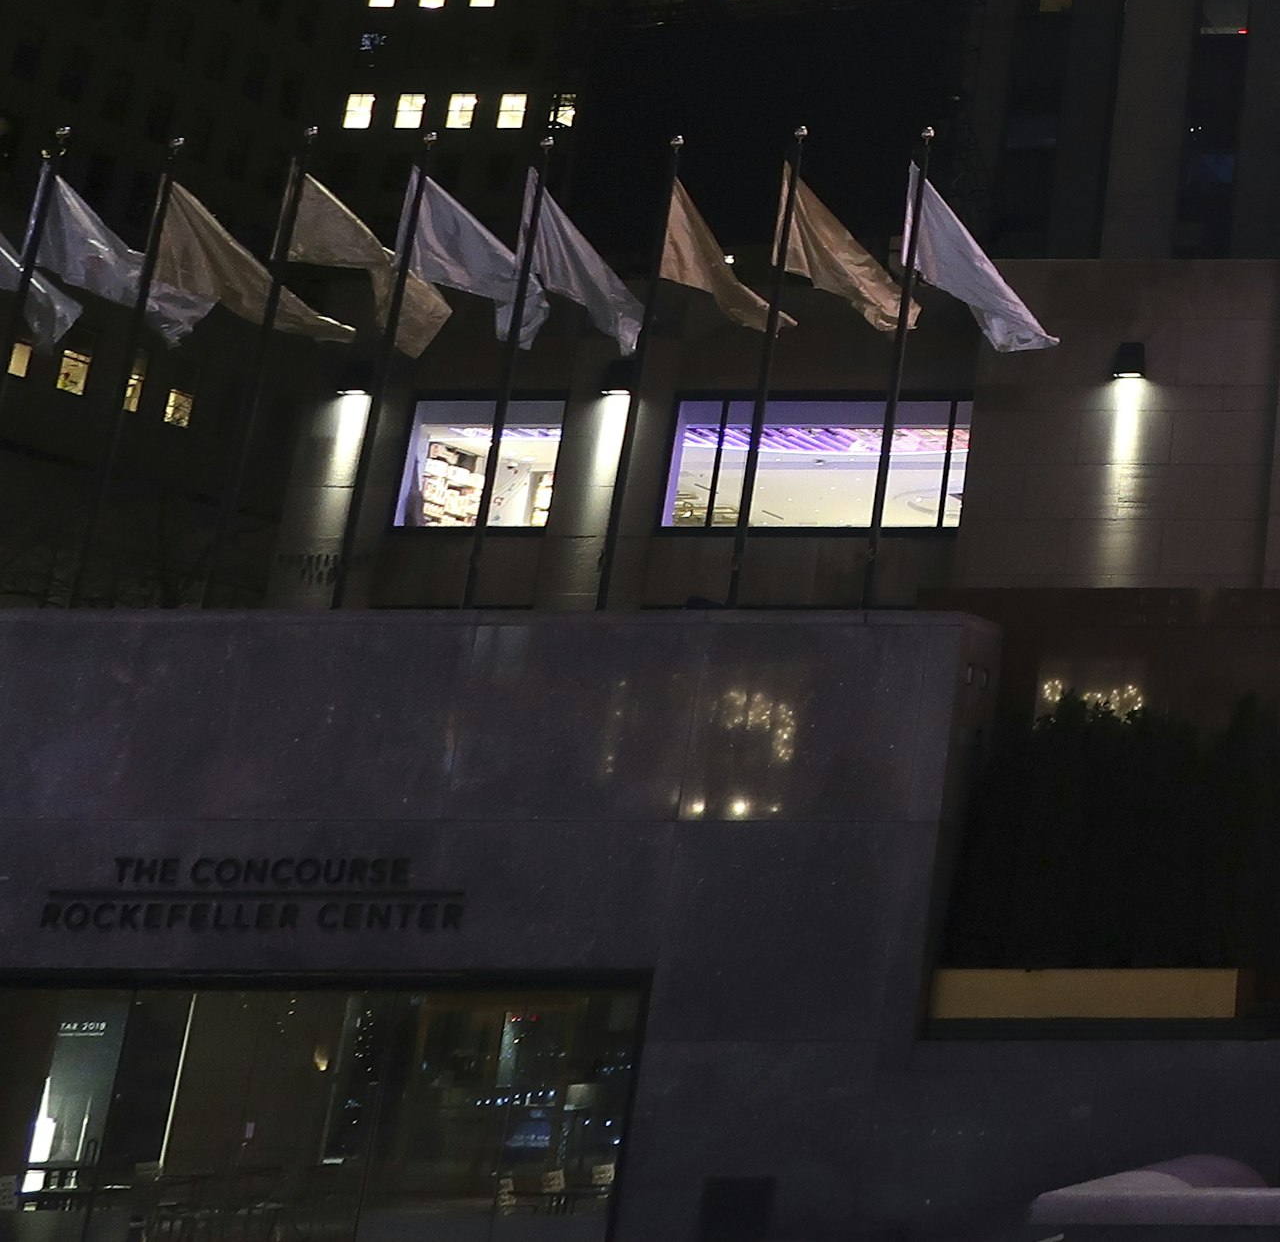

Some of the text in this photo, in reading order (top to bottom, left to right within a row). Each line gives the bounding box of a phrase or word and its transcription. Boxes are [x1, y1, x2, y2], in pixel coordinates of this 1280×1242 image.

[114, 857, 412, 886] THE CONCOURSE
[39, 902, 466, 932] ROCKEFELLER CENTER
